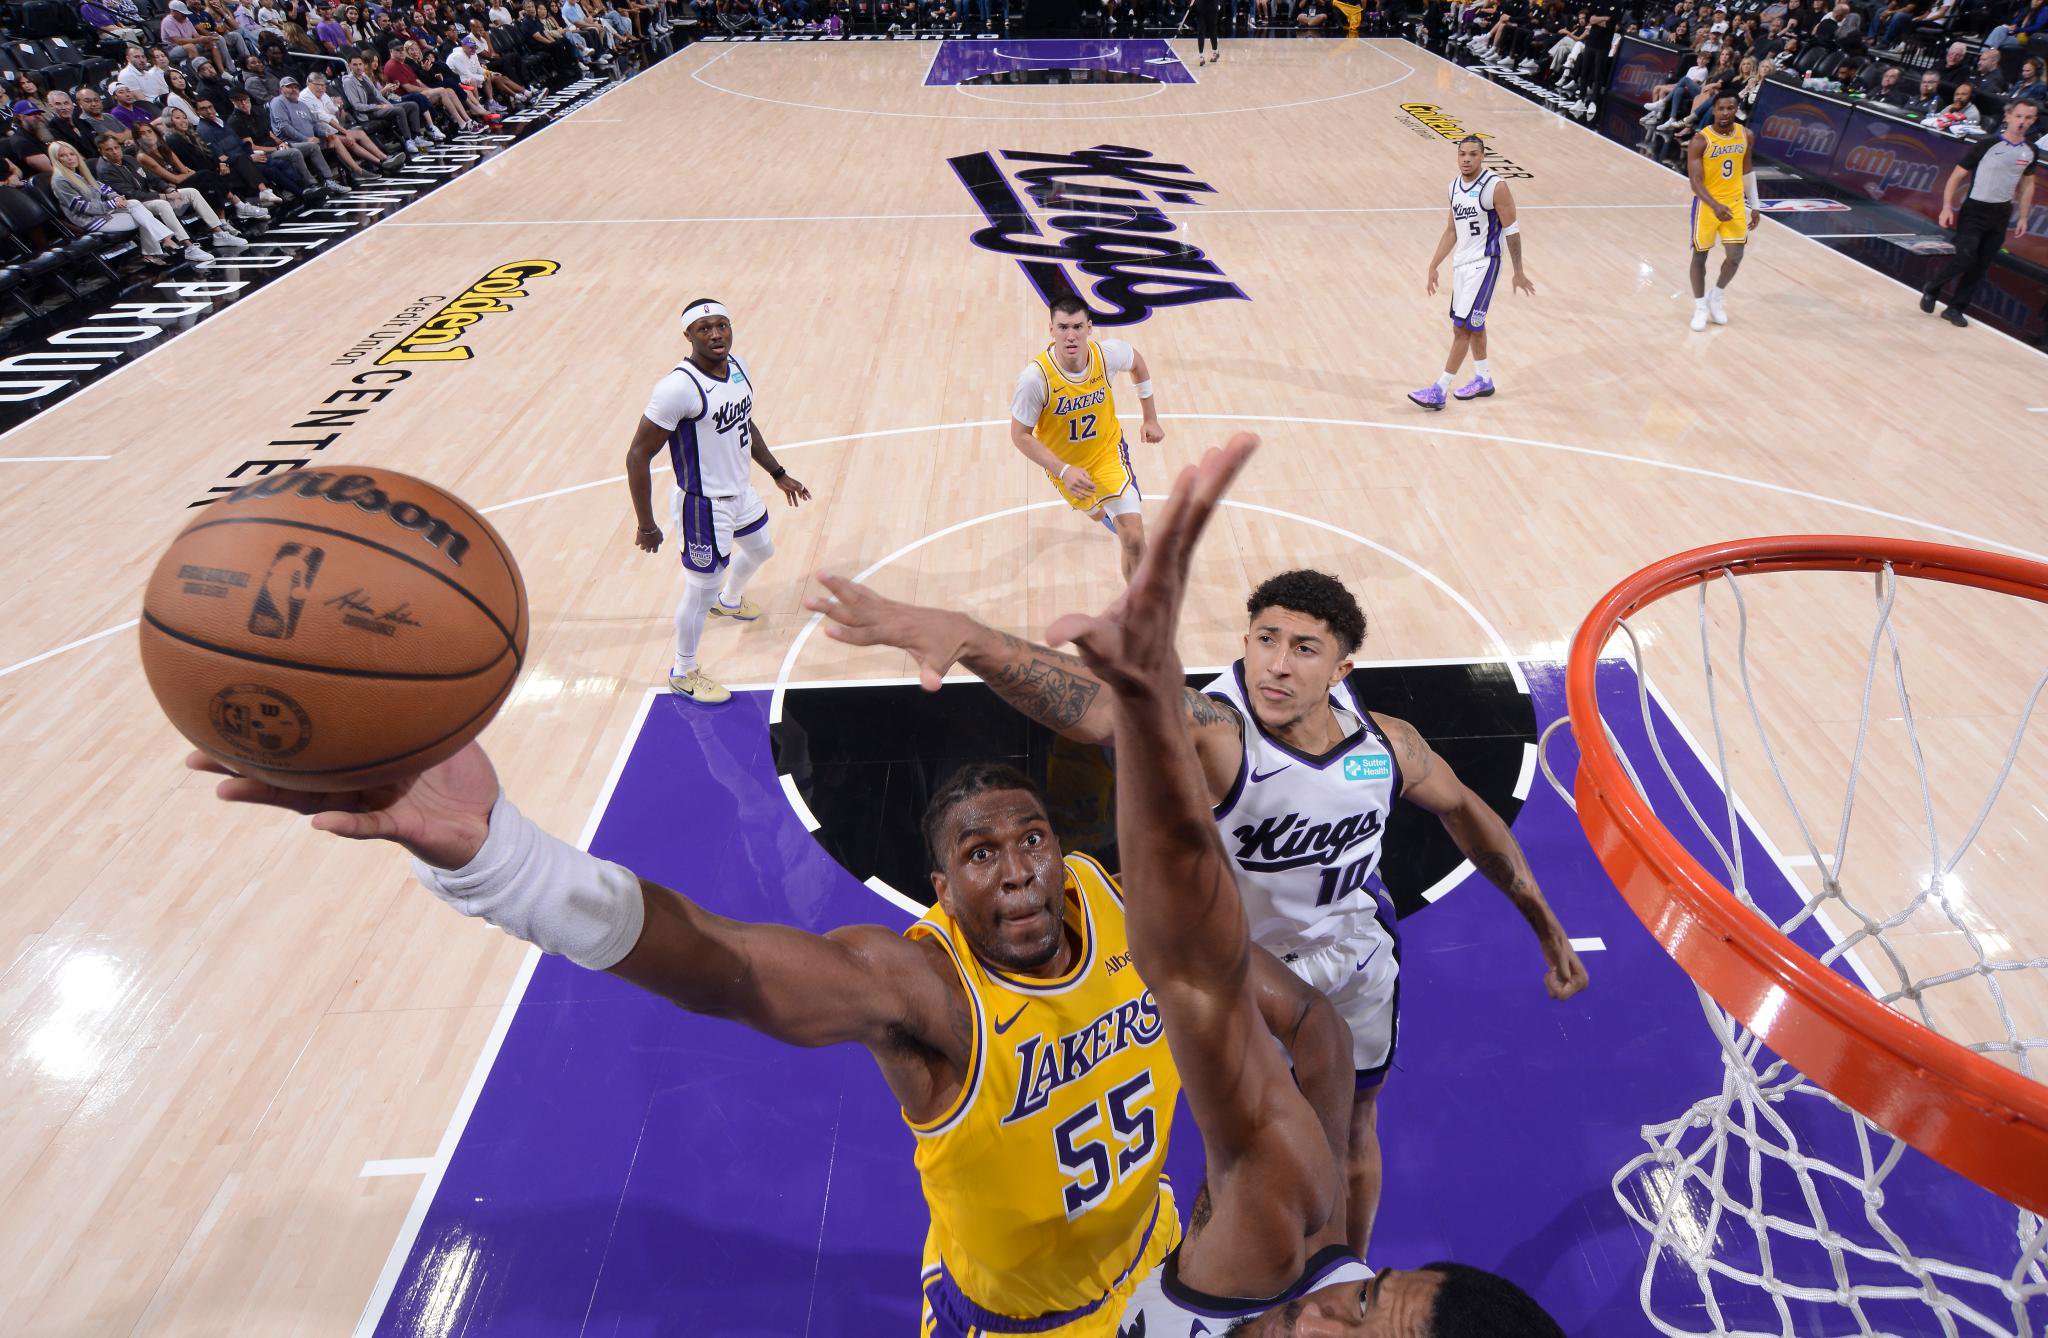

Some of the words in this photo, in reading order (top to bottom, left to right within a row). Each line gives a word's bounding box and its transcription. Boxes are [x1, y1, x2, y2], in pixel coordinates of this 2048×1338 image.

[1710, 144, 1744, 158] LAKERS
[1760, 115, 1836, 157] ampm
[1722, 159, 1734, 179] 9
[1845, 145, 1940, 192] ampm
[195, 134, 517, 269] SACRAMENTO
[1453, 203, 1478, 220] Kings
[946, 144, 1253, 327] Kings
[1469, 221, 1481, 236] 5
[382, 294, 447, 328] Credit
[0, 281, 250, 402] PROUD
[329, 330, 398, 366] Union
[712, 394, 752, 435] Kings
[1053, 387, 1106, 416] LAKERS
[1069, 413, 1098, 441] 12
[1362, 758, 1388, 767] Sutter
[1363, 767, 1389, 776] Health
[1232, 808, 1382, 873] Kings
[1315, 851, 1375, 908] 10
[1104, 950, 1133, 977] Albe
[999, 986, 1165, 1127] LAKERS
[1052, 1066, 1158, 1225] 55
